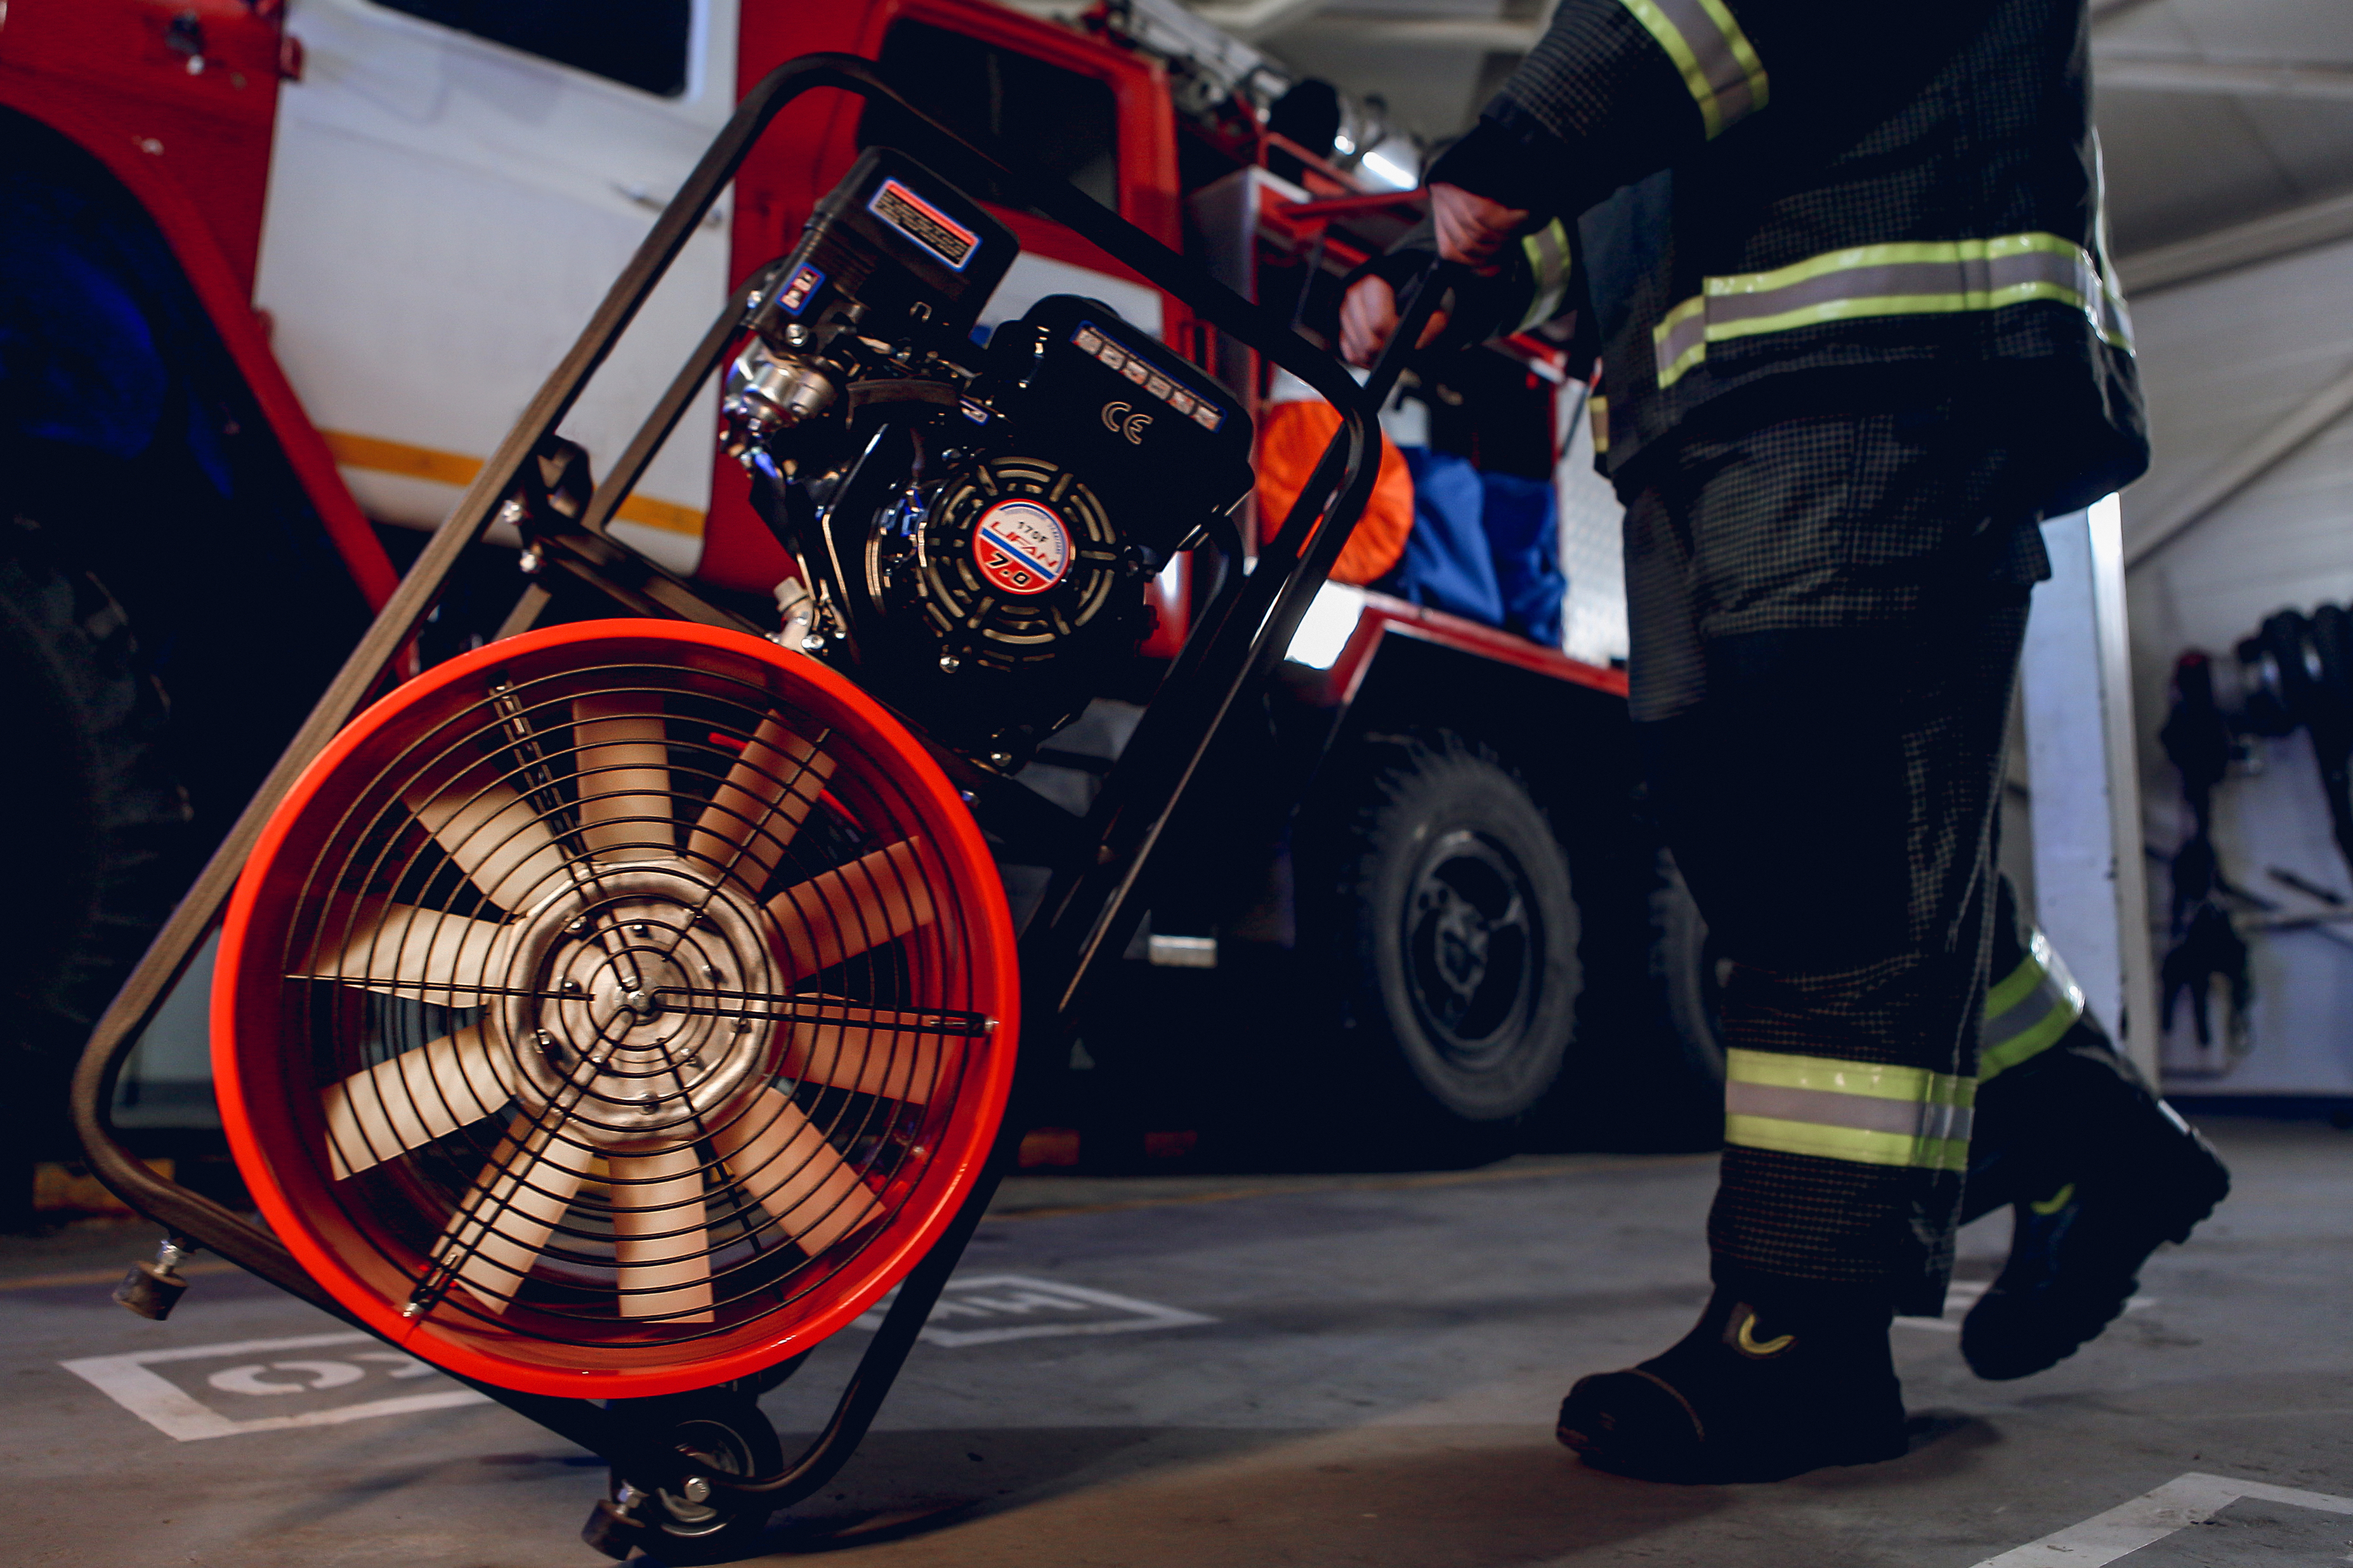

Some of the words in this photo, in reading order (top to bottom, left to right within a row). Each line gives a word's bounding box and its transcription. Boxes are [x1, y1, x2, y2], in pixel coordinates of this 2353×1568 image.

[1101, 401, 1154, 445] CE
[990, 521, 1058, 567] LIFAN
[1017, 521, 1048, 542] 170F
[987, 551, 1030, 585] 7.0
